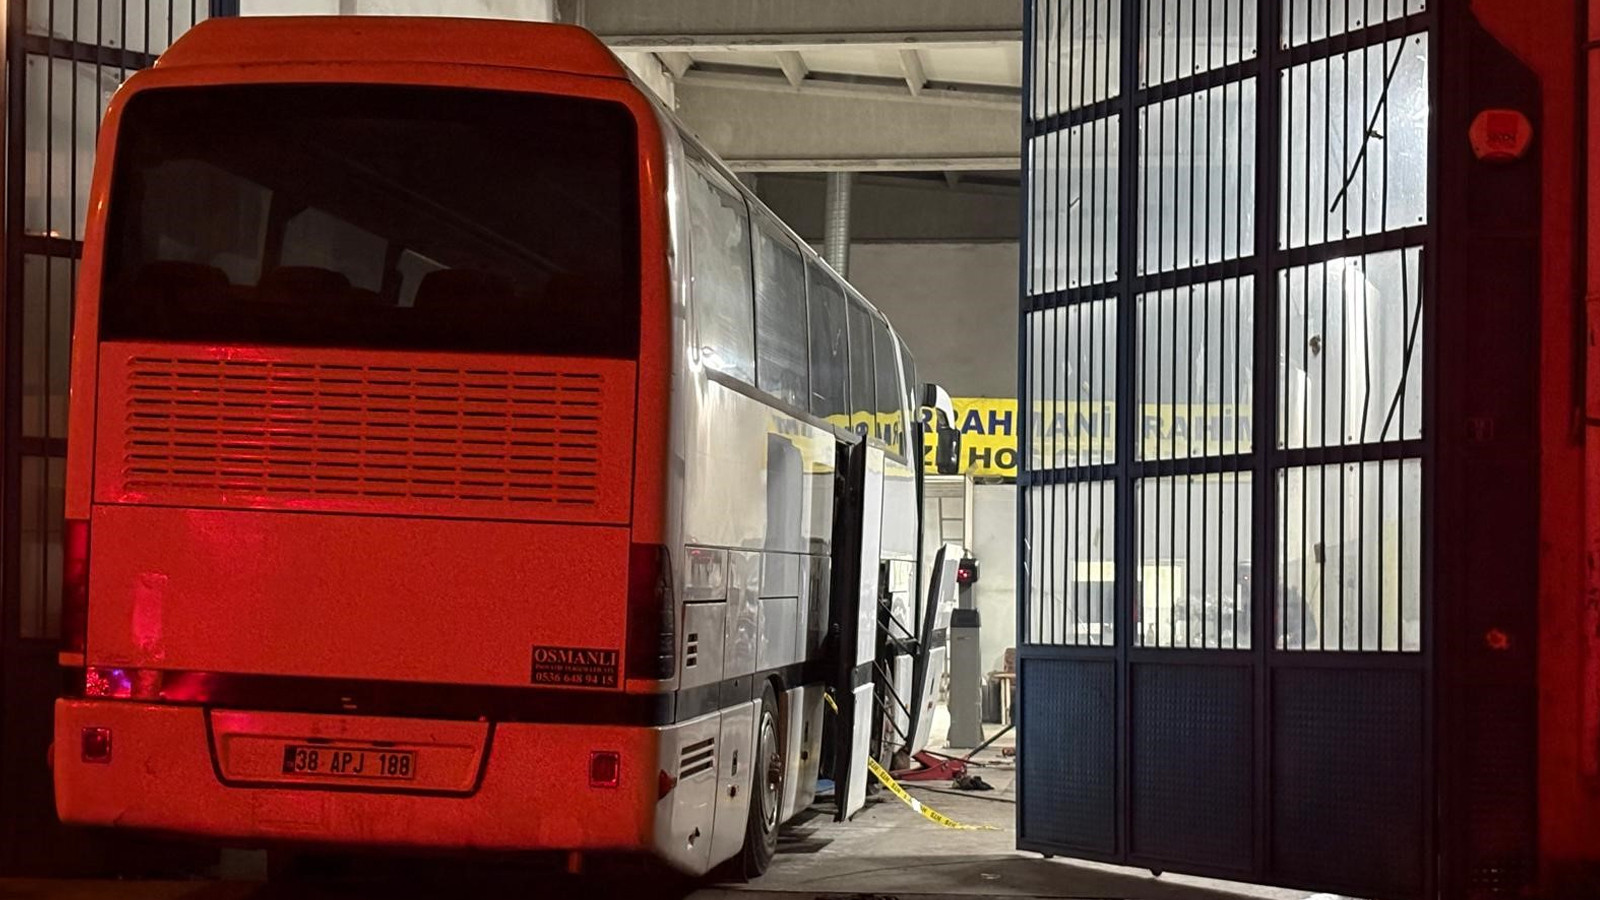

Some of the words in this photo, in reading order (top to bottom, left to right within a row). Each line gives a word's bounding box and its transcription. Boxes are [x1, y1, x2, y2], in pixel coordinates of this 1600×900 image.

[535, 648, 616, 666] OSMANLI
[536, 672, 560, 682] 0536
[563, 673, 583, 683] 648
[585, 674, 598, 684] 94
[602, 675, 614, 685] 15
[296, 750, 318, 771] 38
[330, 752, 365, 773] APJ
[379, 754, 411, 776] 188
